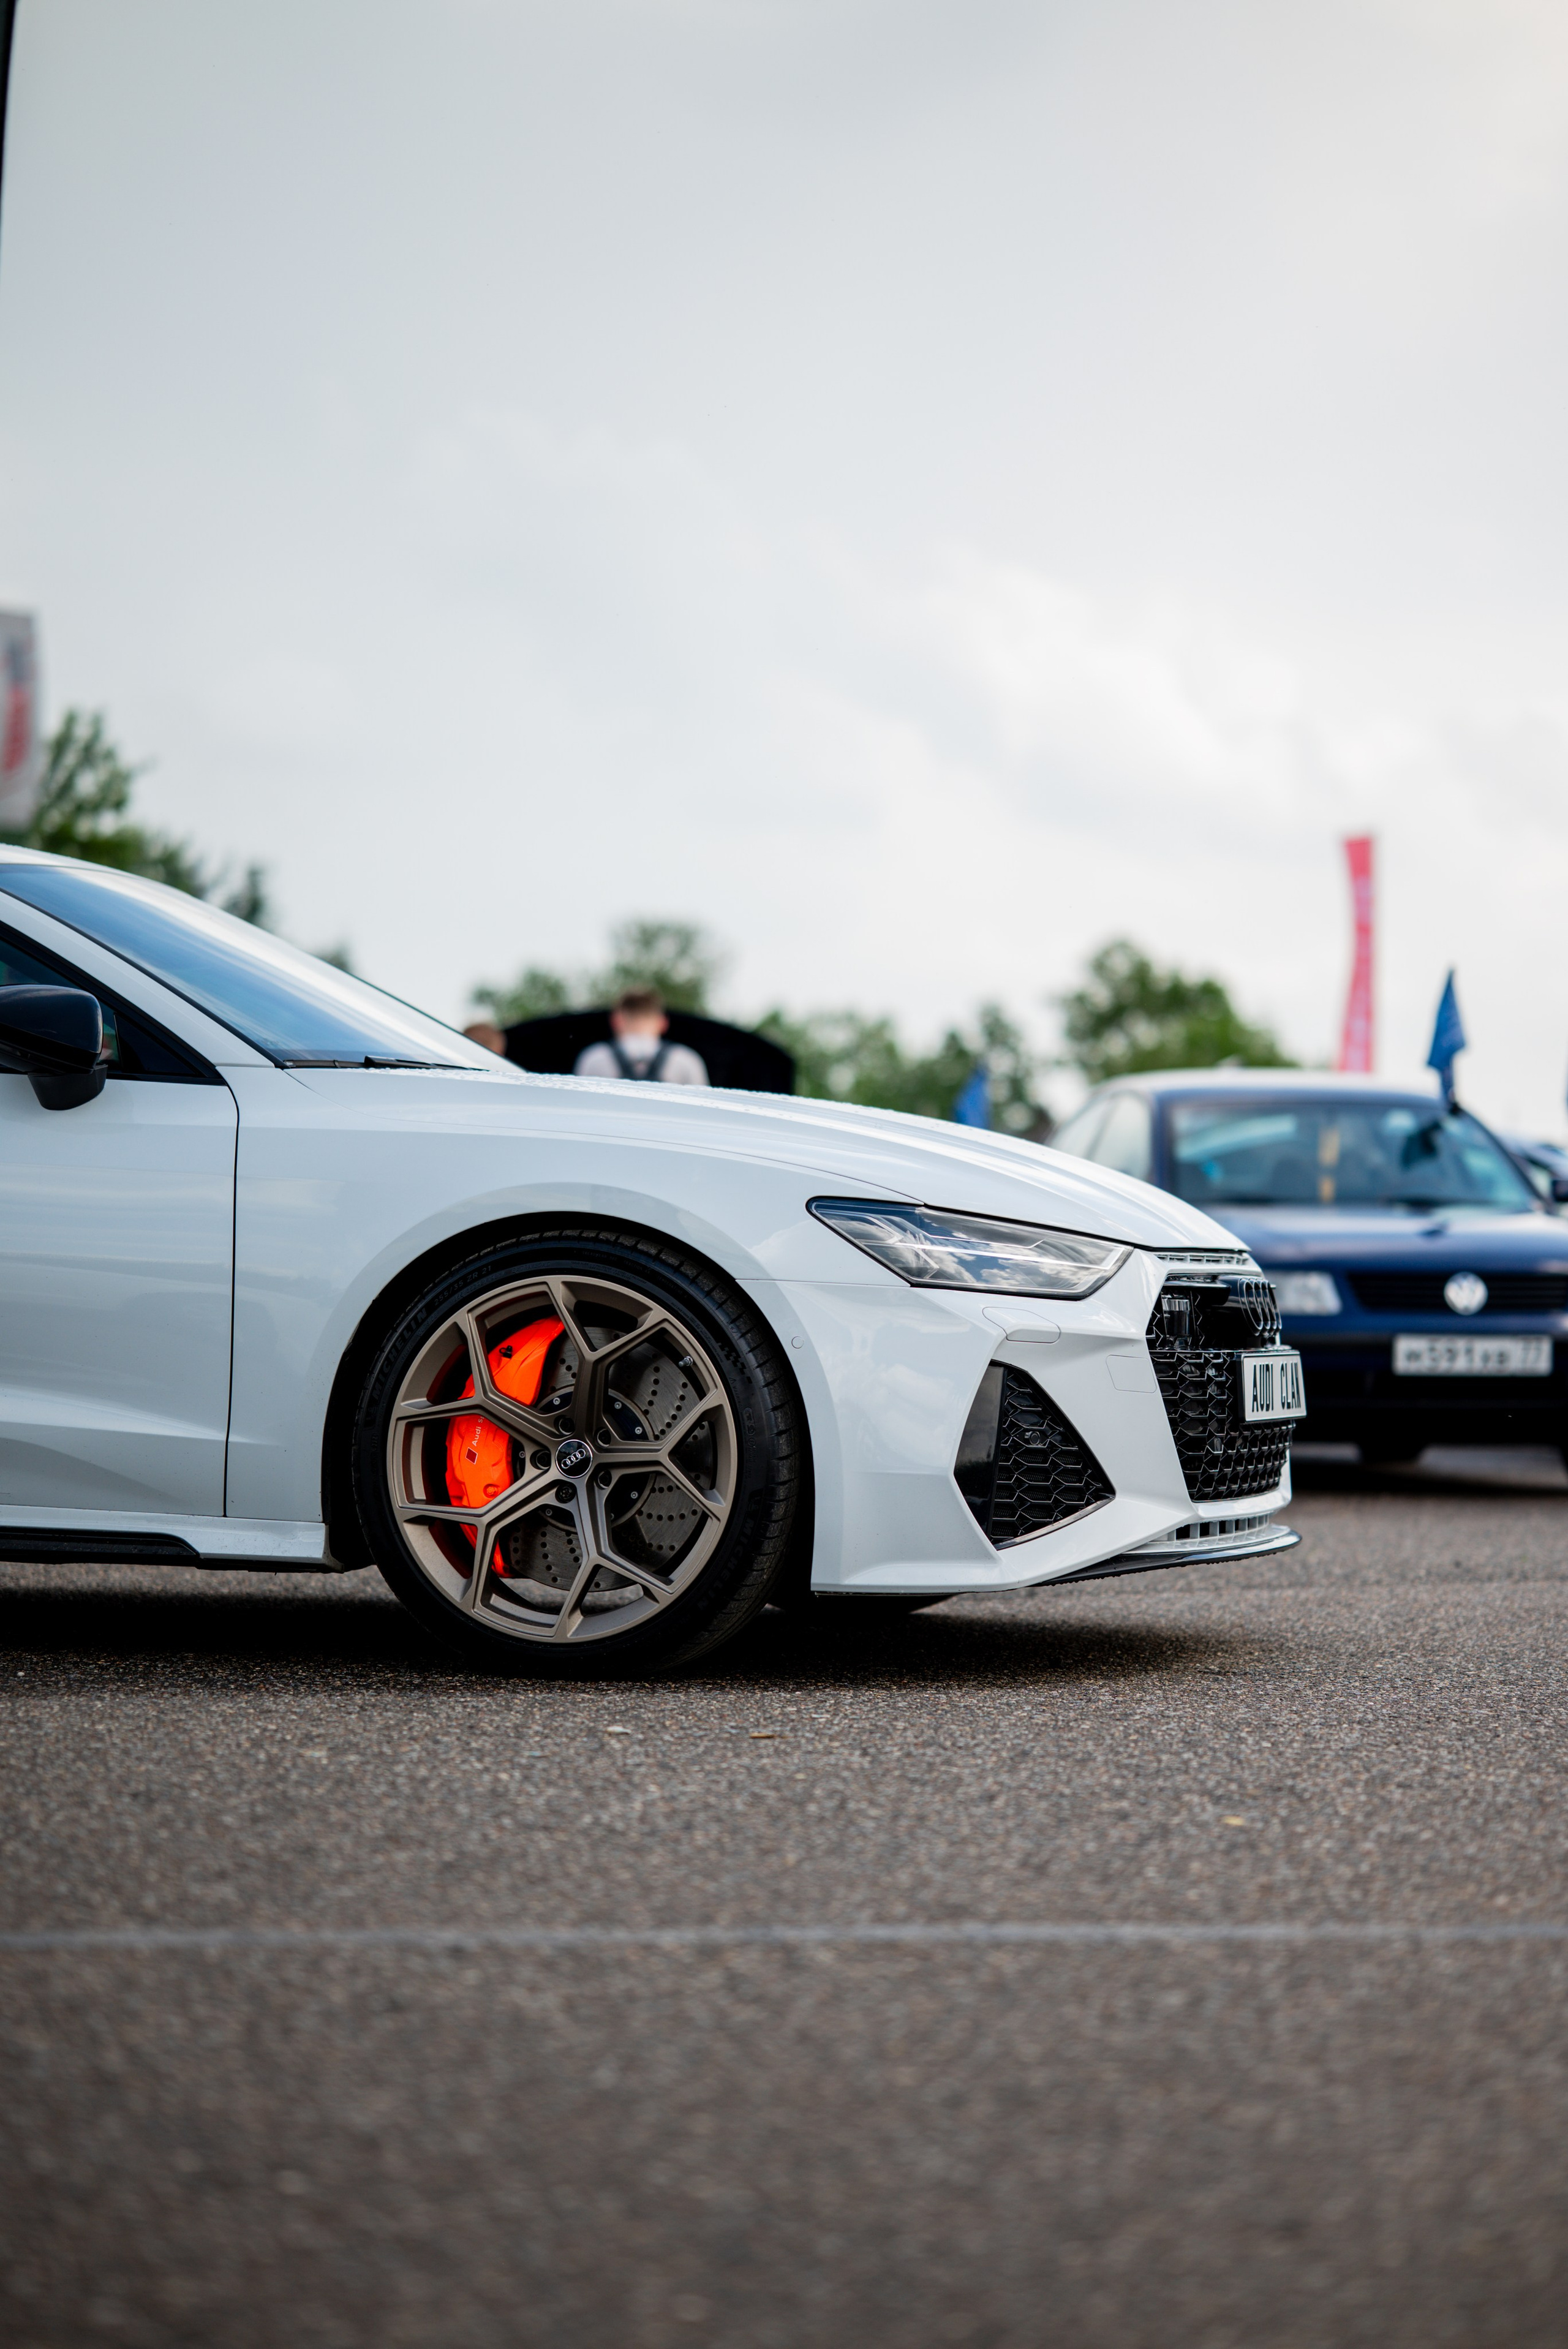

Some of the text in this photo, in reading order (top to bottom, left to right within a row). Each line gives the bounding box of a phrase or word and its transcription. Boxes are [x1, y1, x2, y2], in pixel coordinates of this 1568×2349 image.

[433, 1264, 493, 1306] 255/35 ZR 21
[371, 1306, 428, 1400] MICHELIN
[1251, 1362, 1302, 1413] AUDI CLAN
[472, 1426, 481, 1447] Audi
[696, 1517, 755, 1612] MICHELIN
